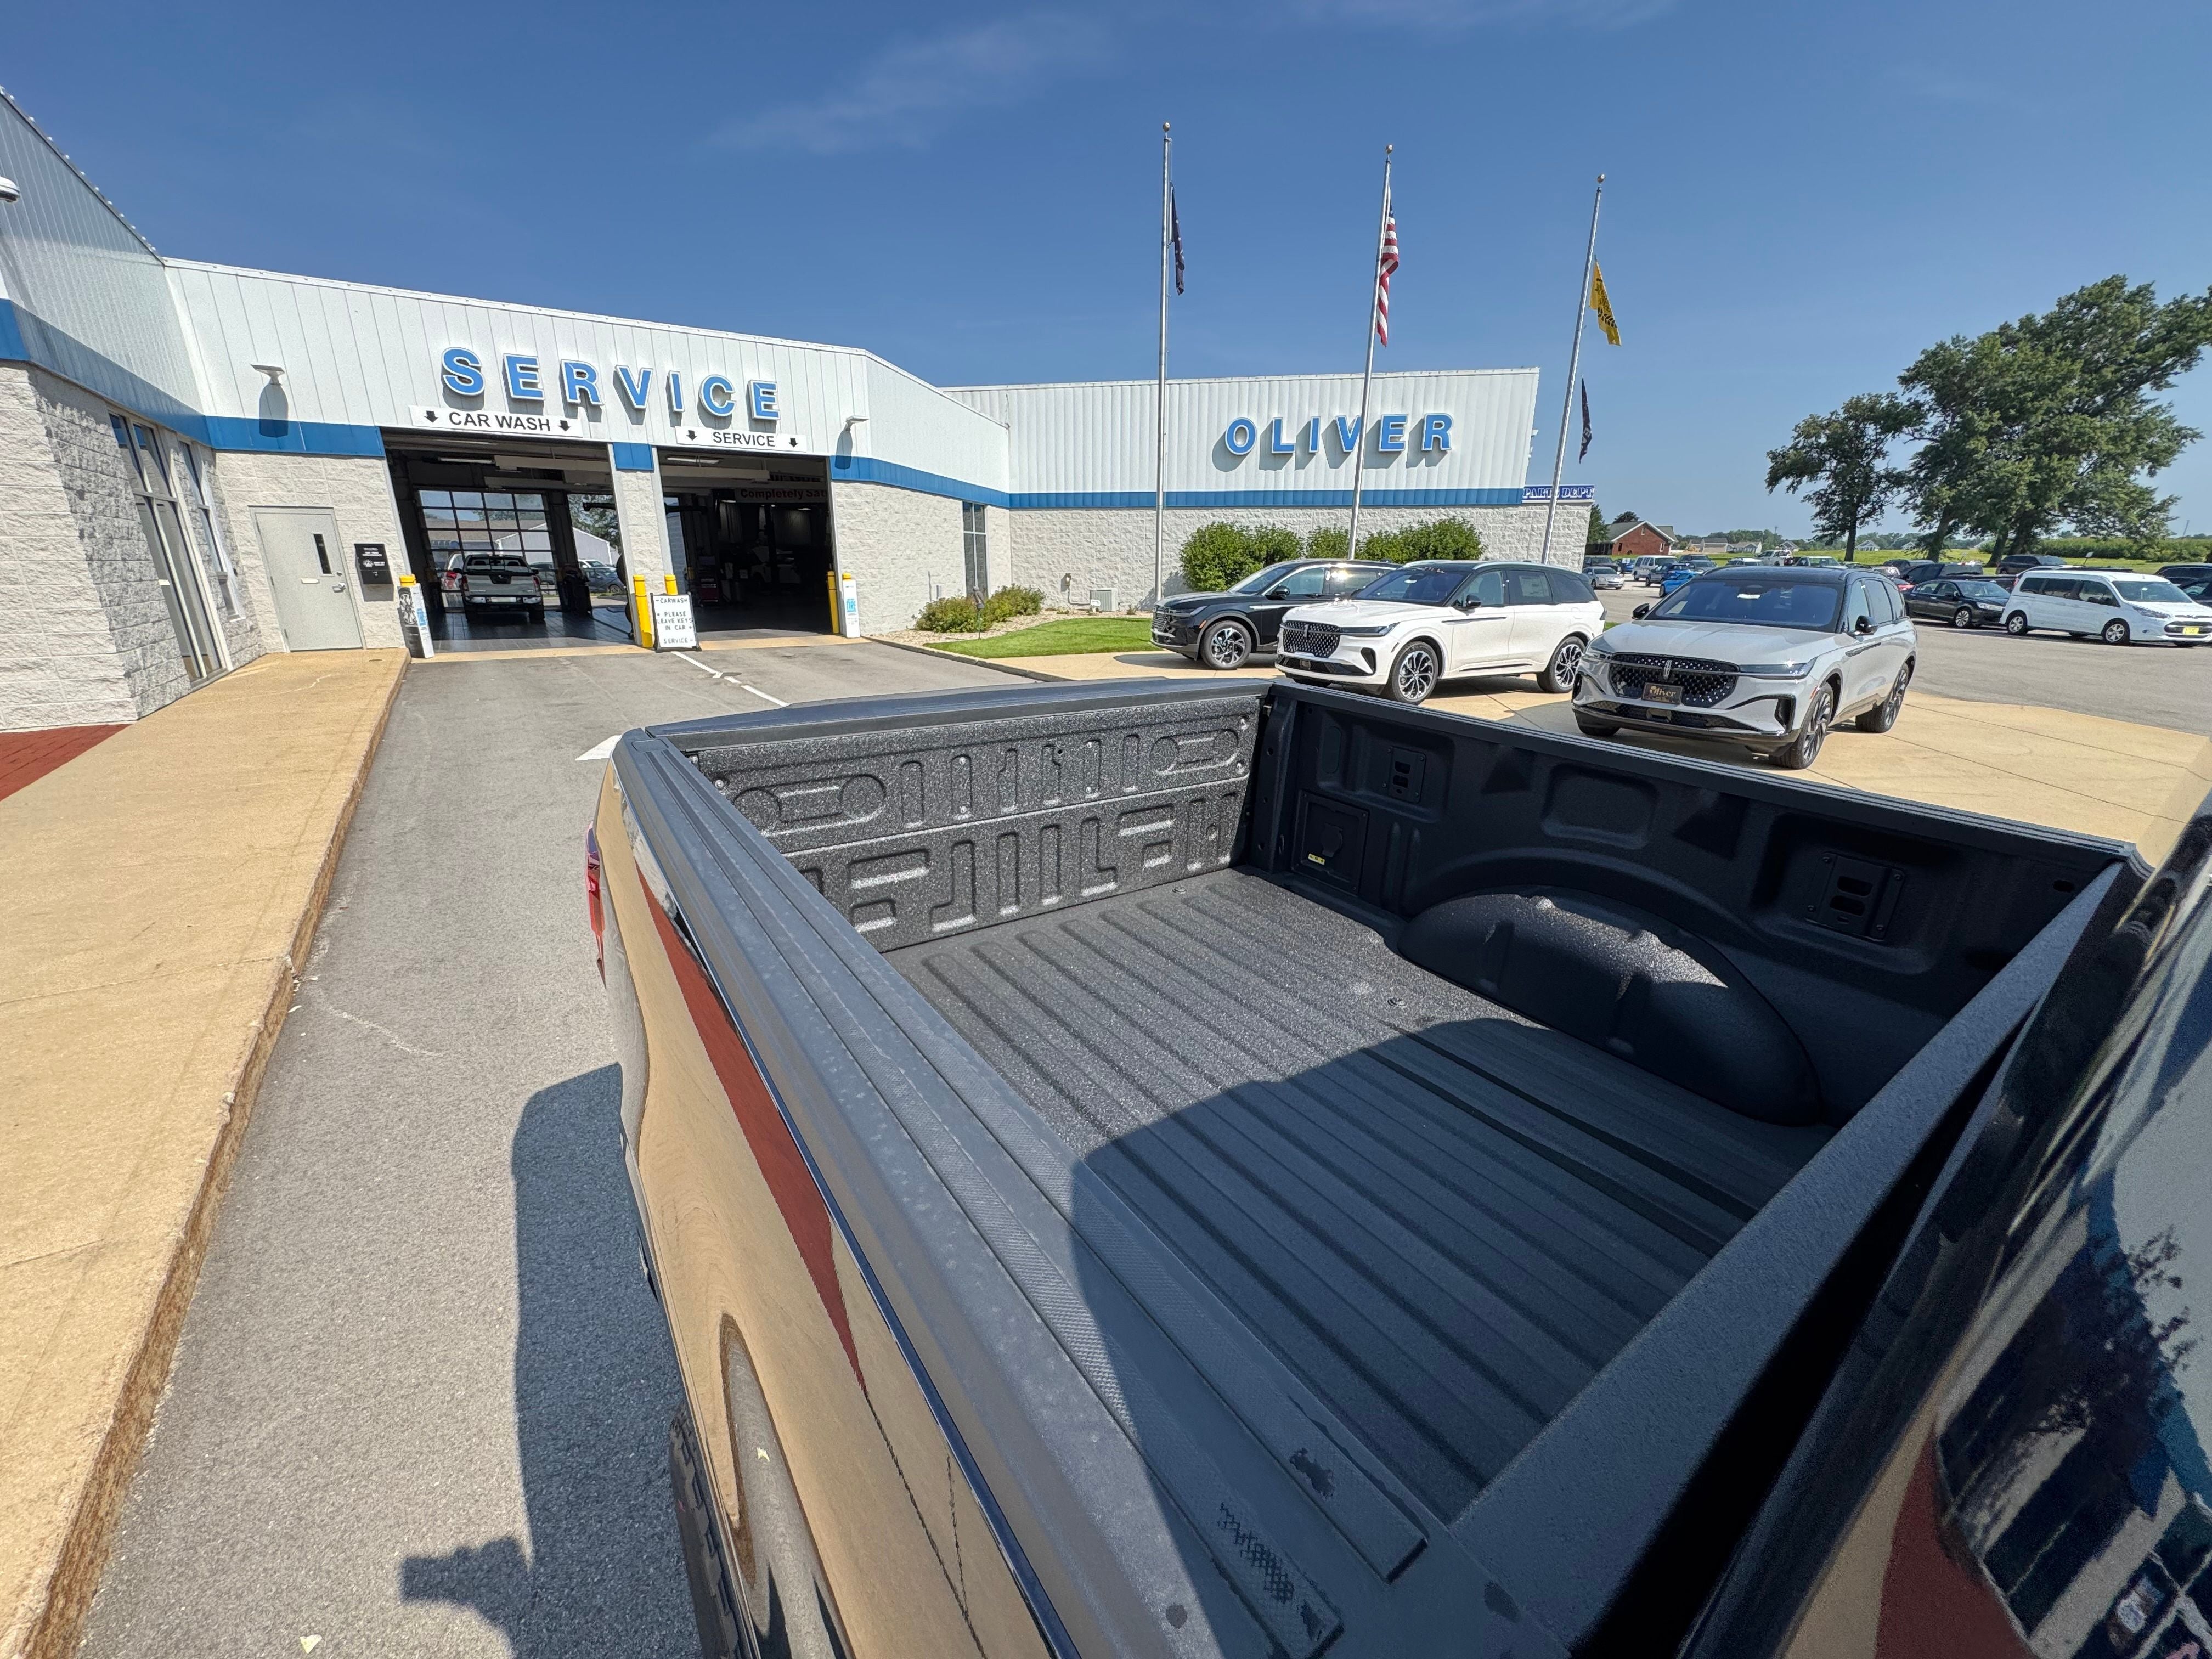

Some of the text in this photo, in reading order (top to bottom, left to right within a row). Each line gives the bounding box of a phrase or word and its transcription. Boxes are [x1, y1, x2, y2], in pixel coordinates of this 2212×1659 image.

[441, 347, 781, 420] SERVICE
[448, 411, 551, 431] CAR WASH
[713, 431, 776, 447] SERVICE
[1225, 413, 1453, 455] OLIVER
[741, 489, 804, 500] Completely
[1522, 487, 1594, 499] PART DEPT
[1650, 685, 1677, 697] Oliver
